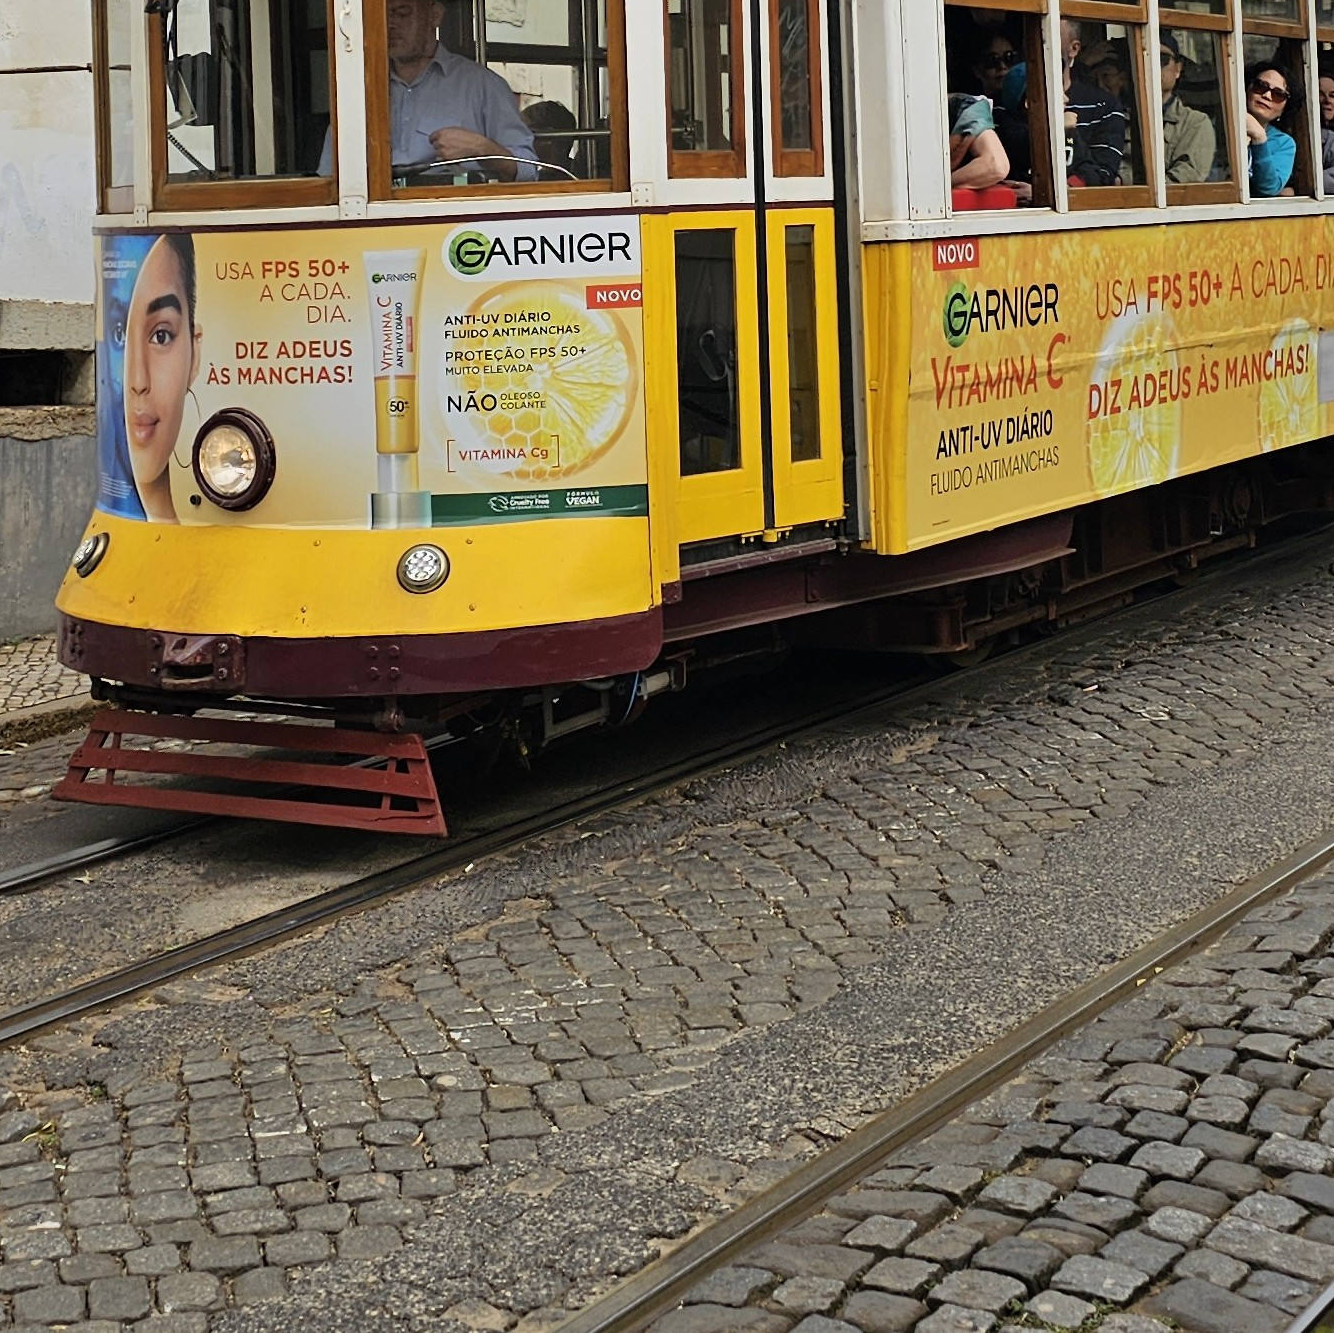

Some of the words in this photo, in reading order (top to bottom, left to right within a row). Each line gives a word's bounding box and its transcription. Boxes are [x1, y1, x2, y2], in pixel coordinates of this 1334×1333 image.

[455, 232, 632, 268] GARNIER
[937, 242, 975, 265] NOVO
[215, 261, 255, 281] USA
[261, 261, 300, 279] FPS
[308, 259, 350, 278] 50+
[371, 272, 417, 284] GARNIER
[259, 284, 274, 302] A
[281, 282, 351, 302] CADA.
[596, 289, 642, 303] NOVO
[1095, 277, 1139, 321] USA
[1146, 273, 1183, 313] FPS
[1188, 269, 1223, 308] 50+
[1229, 262, 1244, 302] A
[1251, 256, 1309, 298] CADA.
[376, 296, 392, 308] C
[947, 283, 1059, 337] GARNIER
[307, 305, 352, 324] DIA.
[395, 302, 403, 331] DIÁRIO
[444, 313, 500, 326] ANTI-UV
[504, 310, 551, 323] DIÁRIO
[380, 311, 393, 372] VITAMINA
[444, 328, 489, 339] FLUIDO
[492, 325, 581, 338] ANTIMANCHAS
[235, 341, 269, 359] DIZ
[276, 340, 353, 359] ADEUS
[396, 331, 404, 368] ANTI-UV
[445, 346, 525, 362] PROTEÇÃO
[530, 347, 556, 359] FPS
[560, 346, 587, 357] 50+
[206, 362, 231, 385] ÀS
[237, 365, 353, 385] MANCHAS!
[445, 366, 480, 376] MUITO
[483, 364, 534, 374] ELEVADA
[931, 354, 1038, 410] VITAMINA
[1087, 378, 1122, 420] DIZ
[1128, 365, 1191, 411] ADEUS
[1196, 354, 1220, 396] ÀS
[1225, 343, 1309, 390] MANCHAS!
[447, 391, 498, 413] NÃO
[500, 391, 541, 401] OLEOSO
[500, 401, 547, 410] COLANTE
[936, 419, 1003, 460] ANTI-UV
[1006, 406, 1053, 445] DIÁRIO
[459, 448, 527, 462] VITAMINA
[530, 447, 549, 460] Cg
[930, 466, 973, 496] FLUIDO
[975, 446, 1059, 486] ANTIMANCHAS
[565, 495, 600, 506] VEGAN
